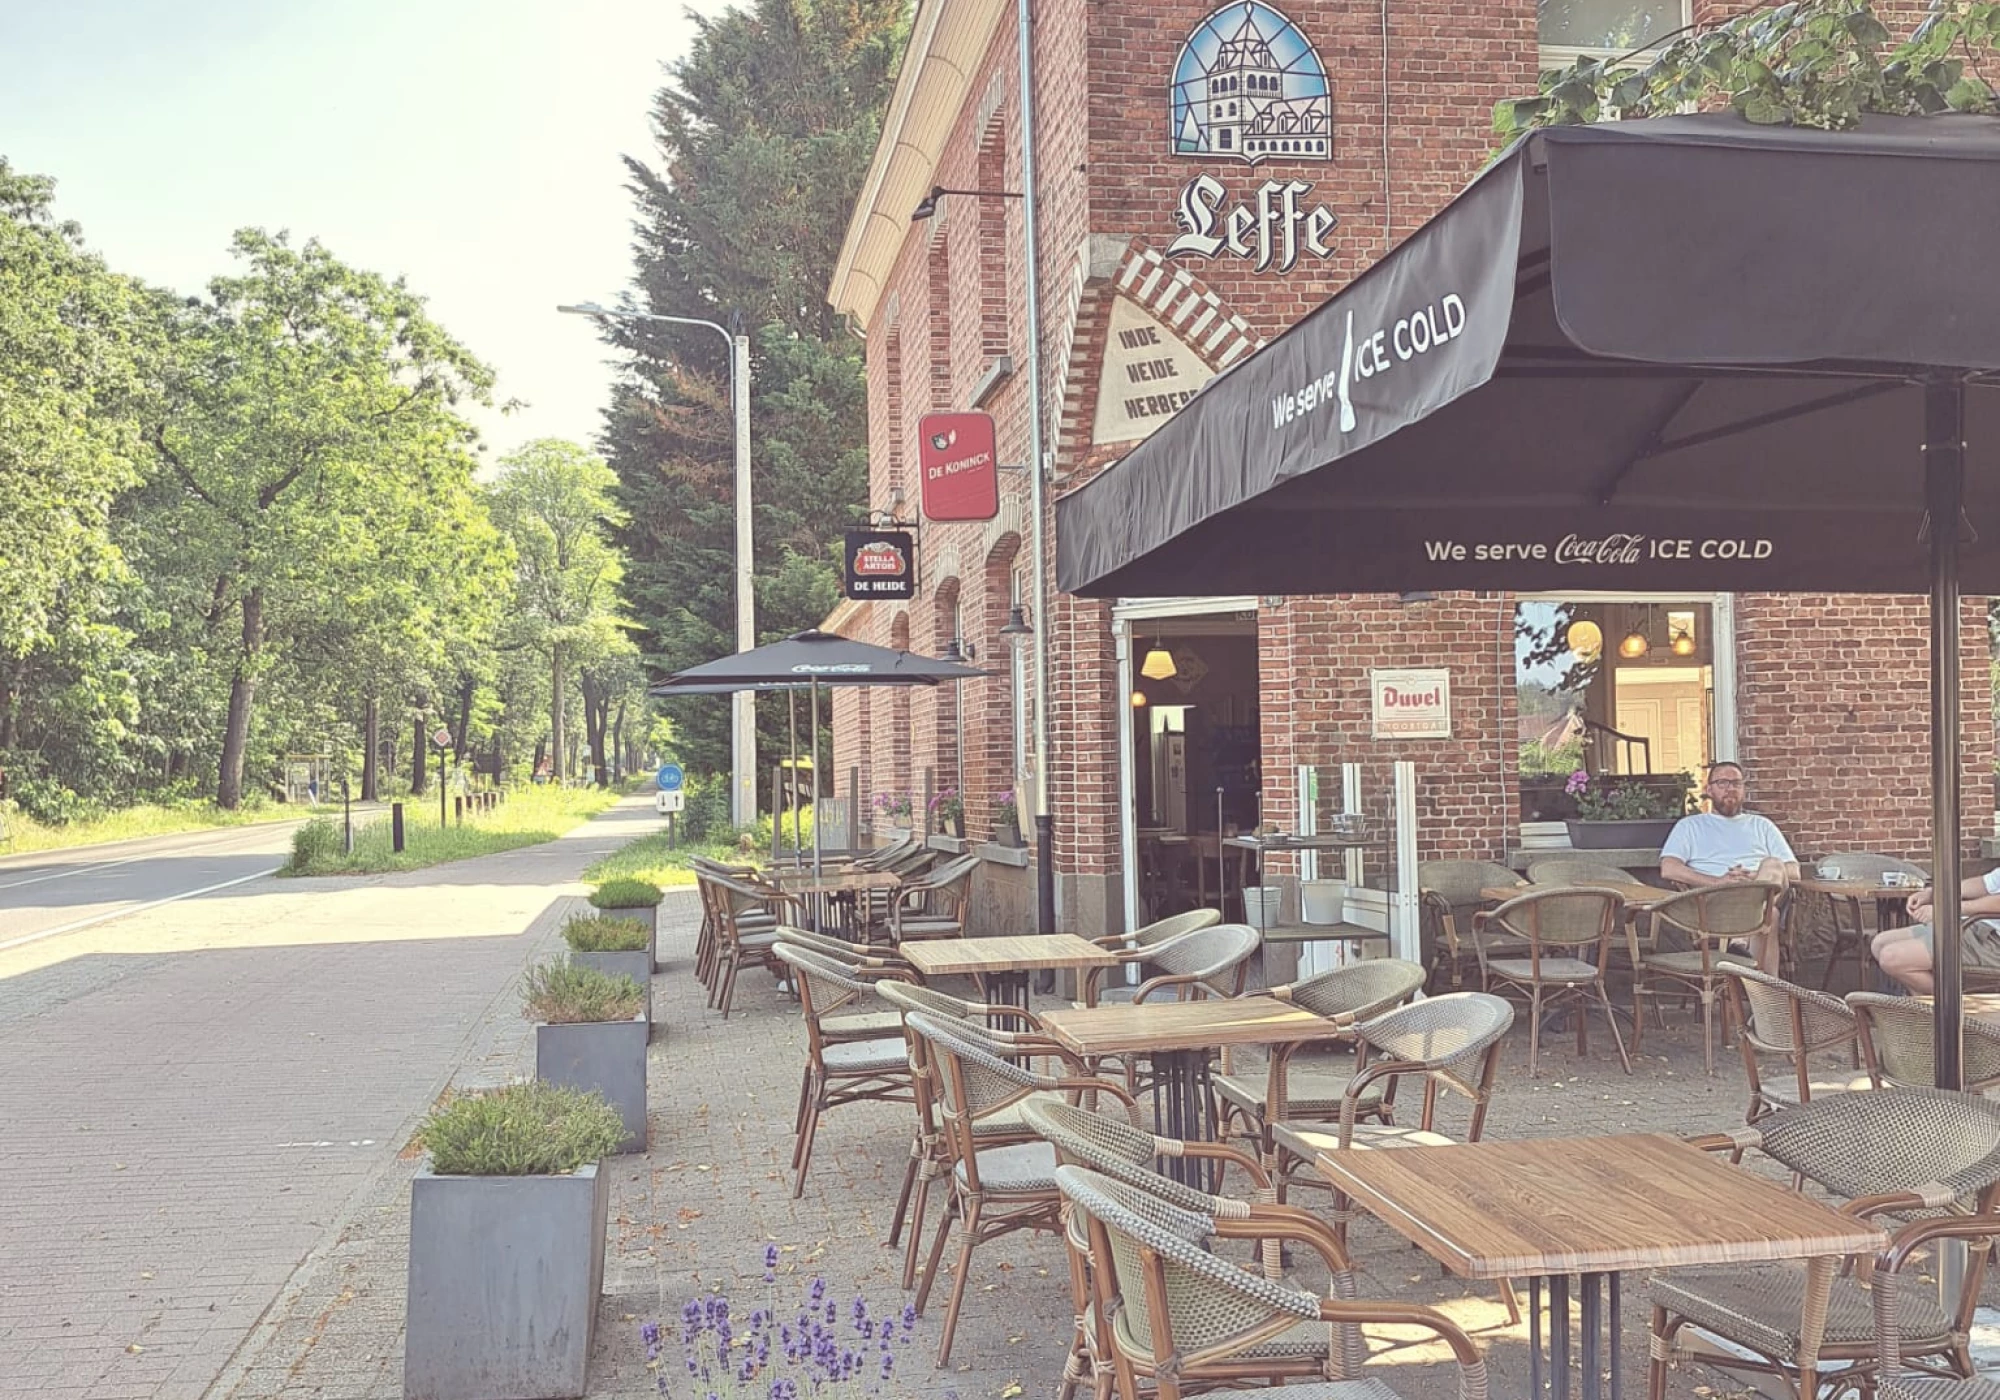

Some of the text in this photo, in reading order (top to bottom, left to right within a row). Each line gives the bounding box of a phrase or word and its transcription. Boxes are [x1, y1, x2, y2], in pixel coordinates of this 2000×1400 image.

[1165, 173, 1338, 275] Leffe
[1126, 358, 1179, 383] HEIDE
[1272, 294, 1466, 429] We serve ICE COLD
[945, 451, 990, 476] KONINCK
[1424, 541, 1467, 561] We
[1474, 543, 1548, 561] serve
[1650, 539, 1692, 559] ICE
[1700, 539, 1773, 559] COLD
[854, 581, 907, 591] DE HEIDE
[1384, 686, 1440, 707] Duvel
